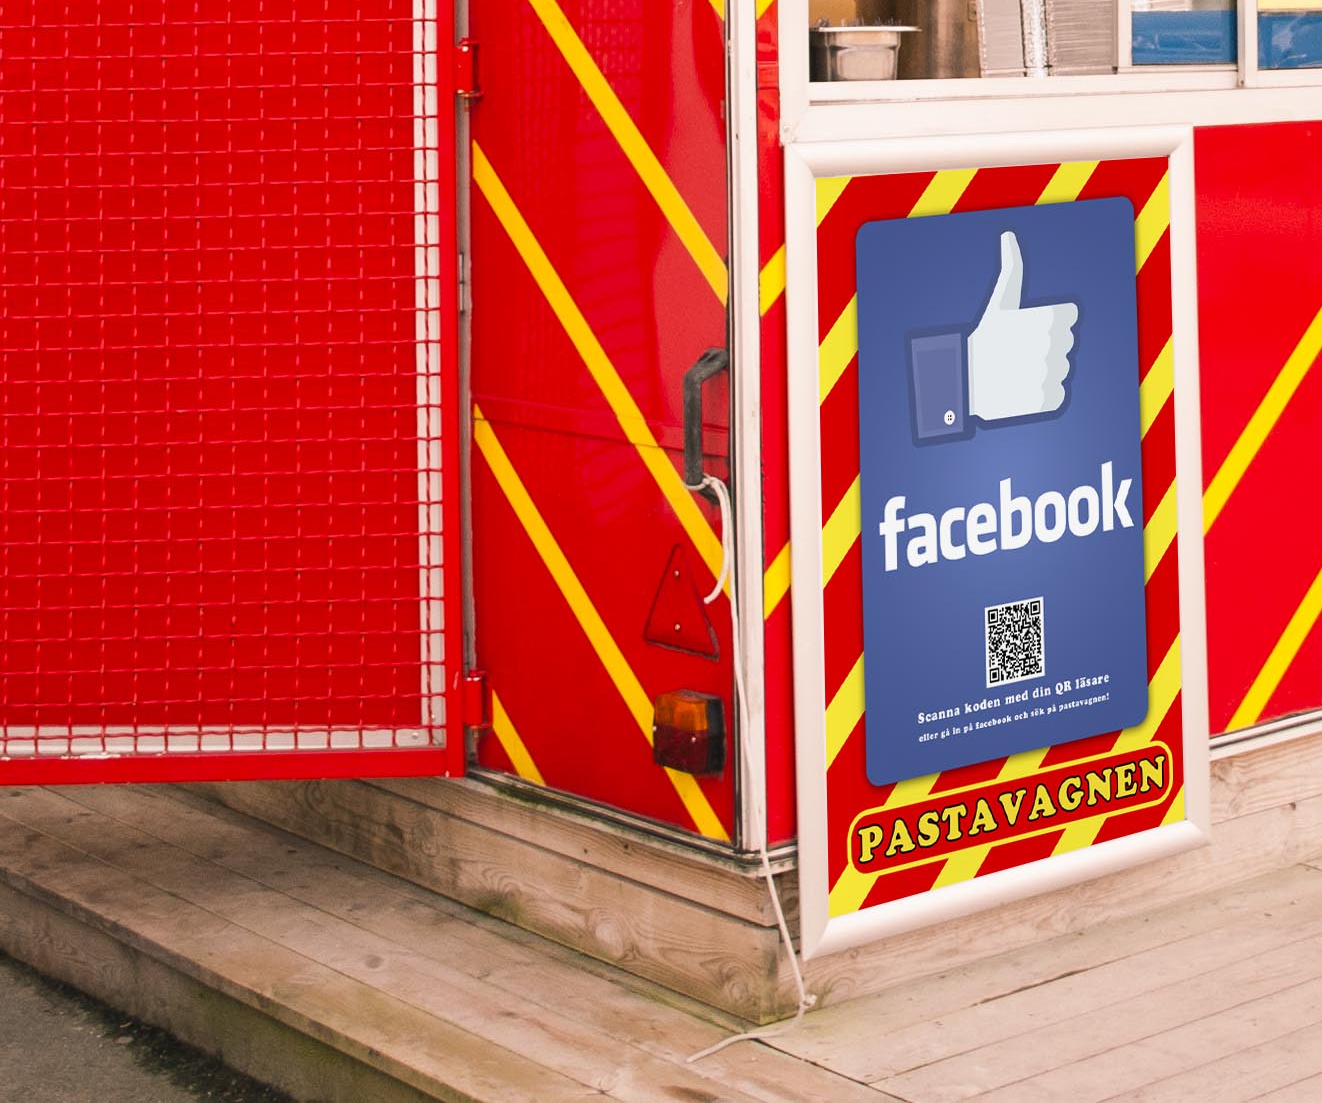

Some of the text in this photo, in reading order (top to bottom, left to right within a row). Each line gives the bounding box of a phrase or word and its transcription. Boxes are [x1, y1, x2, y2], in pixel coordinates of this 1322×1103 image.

[878, 460, 1135, 572] facebook
[917, 674, 1110, 724] Scanna koden med din QR läsare
[918, 693, 1110, 743] eller gå in på facebook och sök på pastavagnen!
[857, 755, 1166, 864] PASTAVAGNEN
